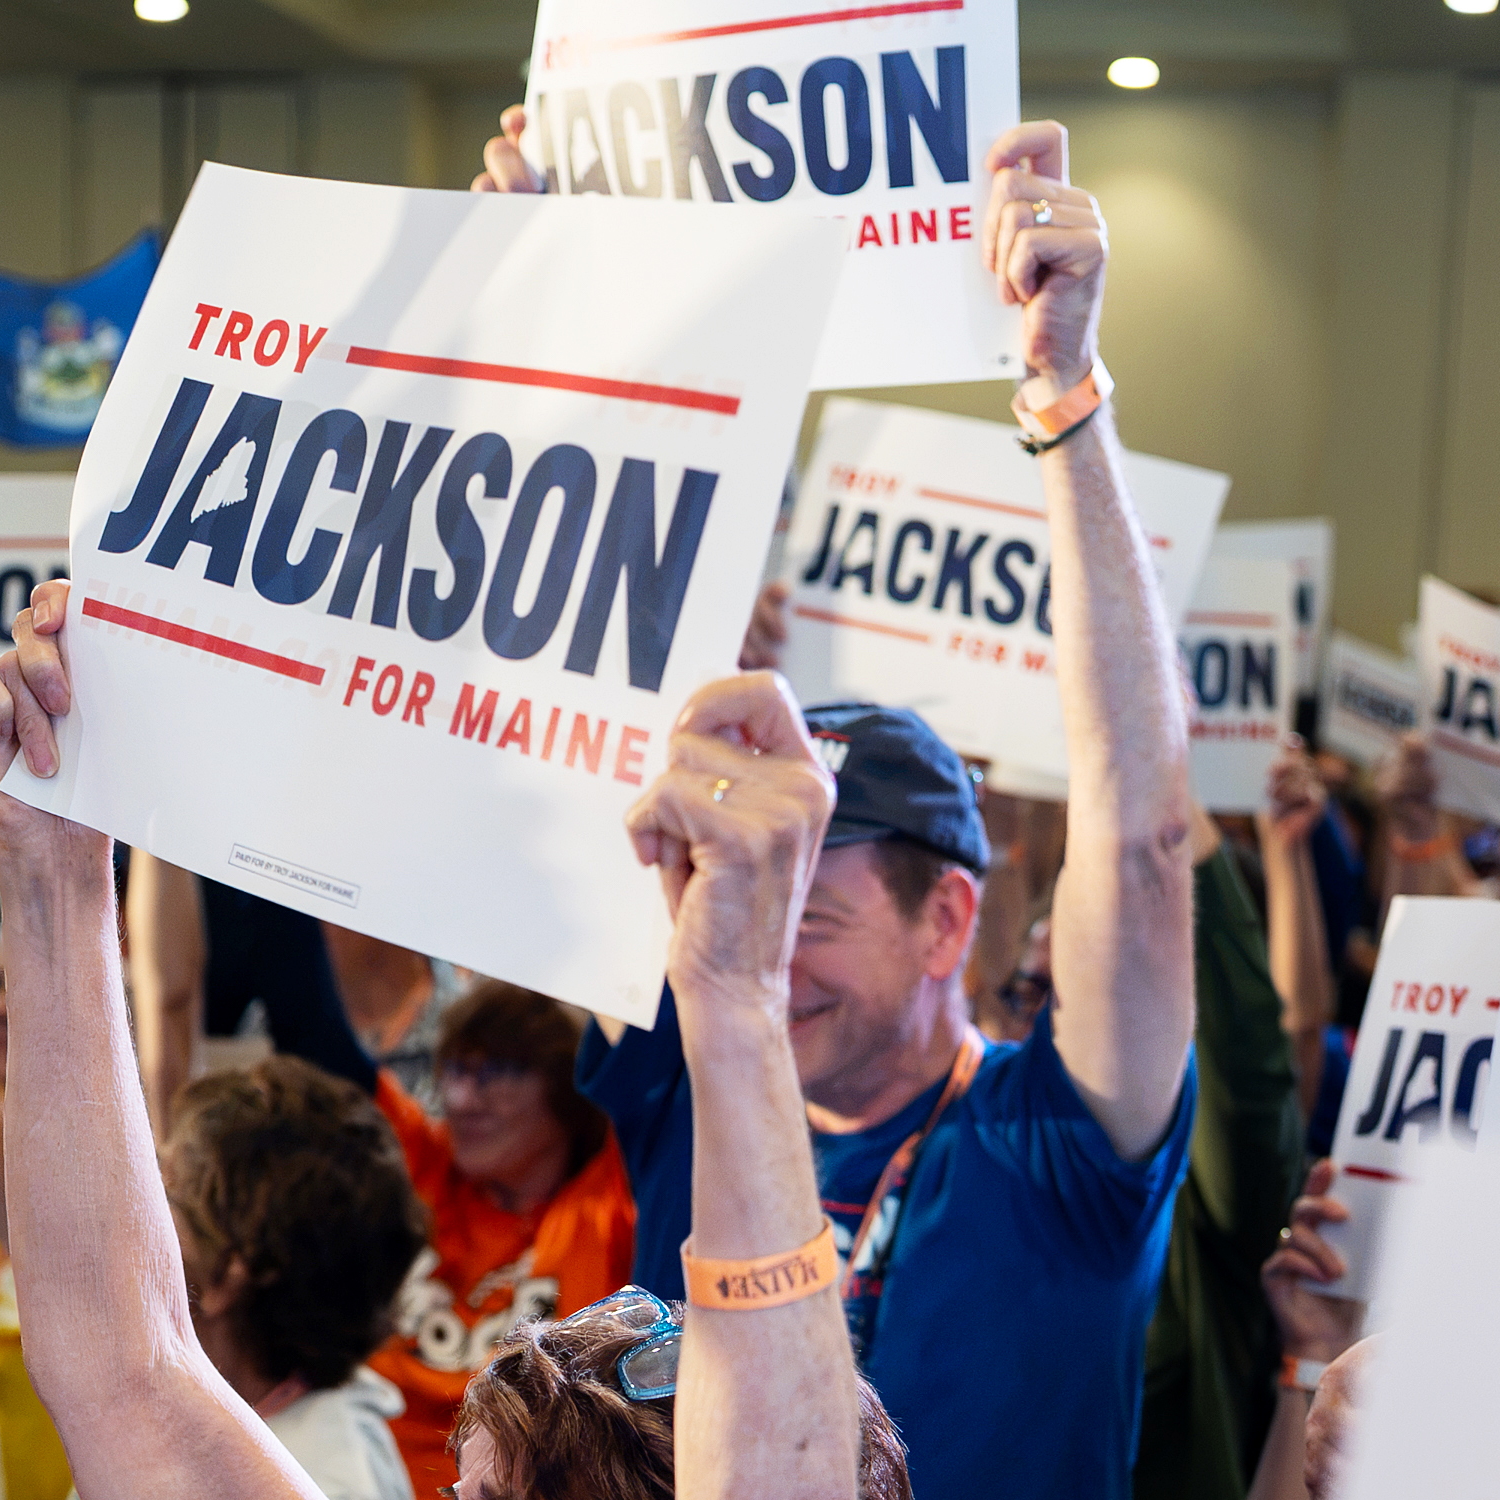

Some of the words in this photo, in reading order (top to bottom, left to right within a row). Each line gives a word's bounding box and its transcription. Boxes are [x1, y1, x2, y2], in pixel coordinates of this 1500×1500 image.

[537, 45, 969, 203] JACKSON
[848, 206, 972, 251] AINE
[188, 303, 328, 373] TROY
[98, 377, 719, 694] JACKSON
[802, 503, 1054, 637] JACKS
[343, 656, 435, 727] FOR
[449, 683, 651, 787] MAINE
[235, 851, 252, 863] PAID
[251, 858, 265, 870] FOR
[264, 861, 274, 871] BY
[274, 865, 289, 876] TROY
[288, 869, 318, 886] JACKSON
[1391, 980, 1469, 1018] TROY
